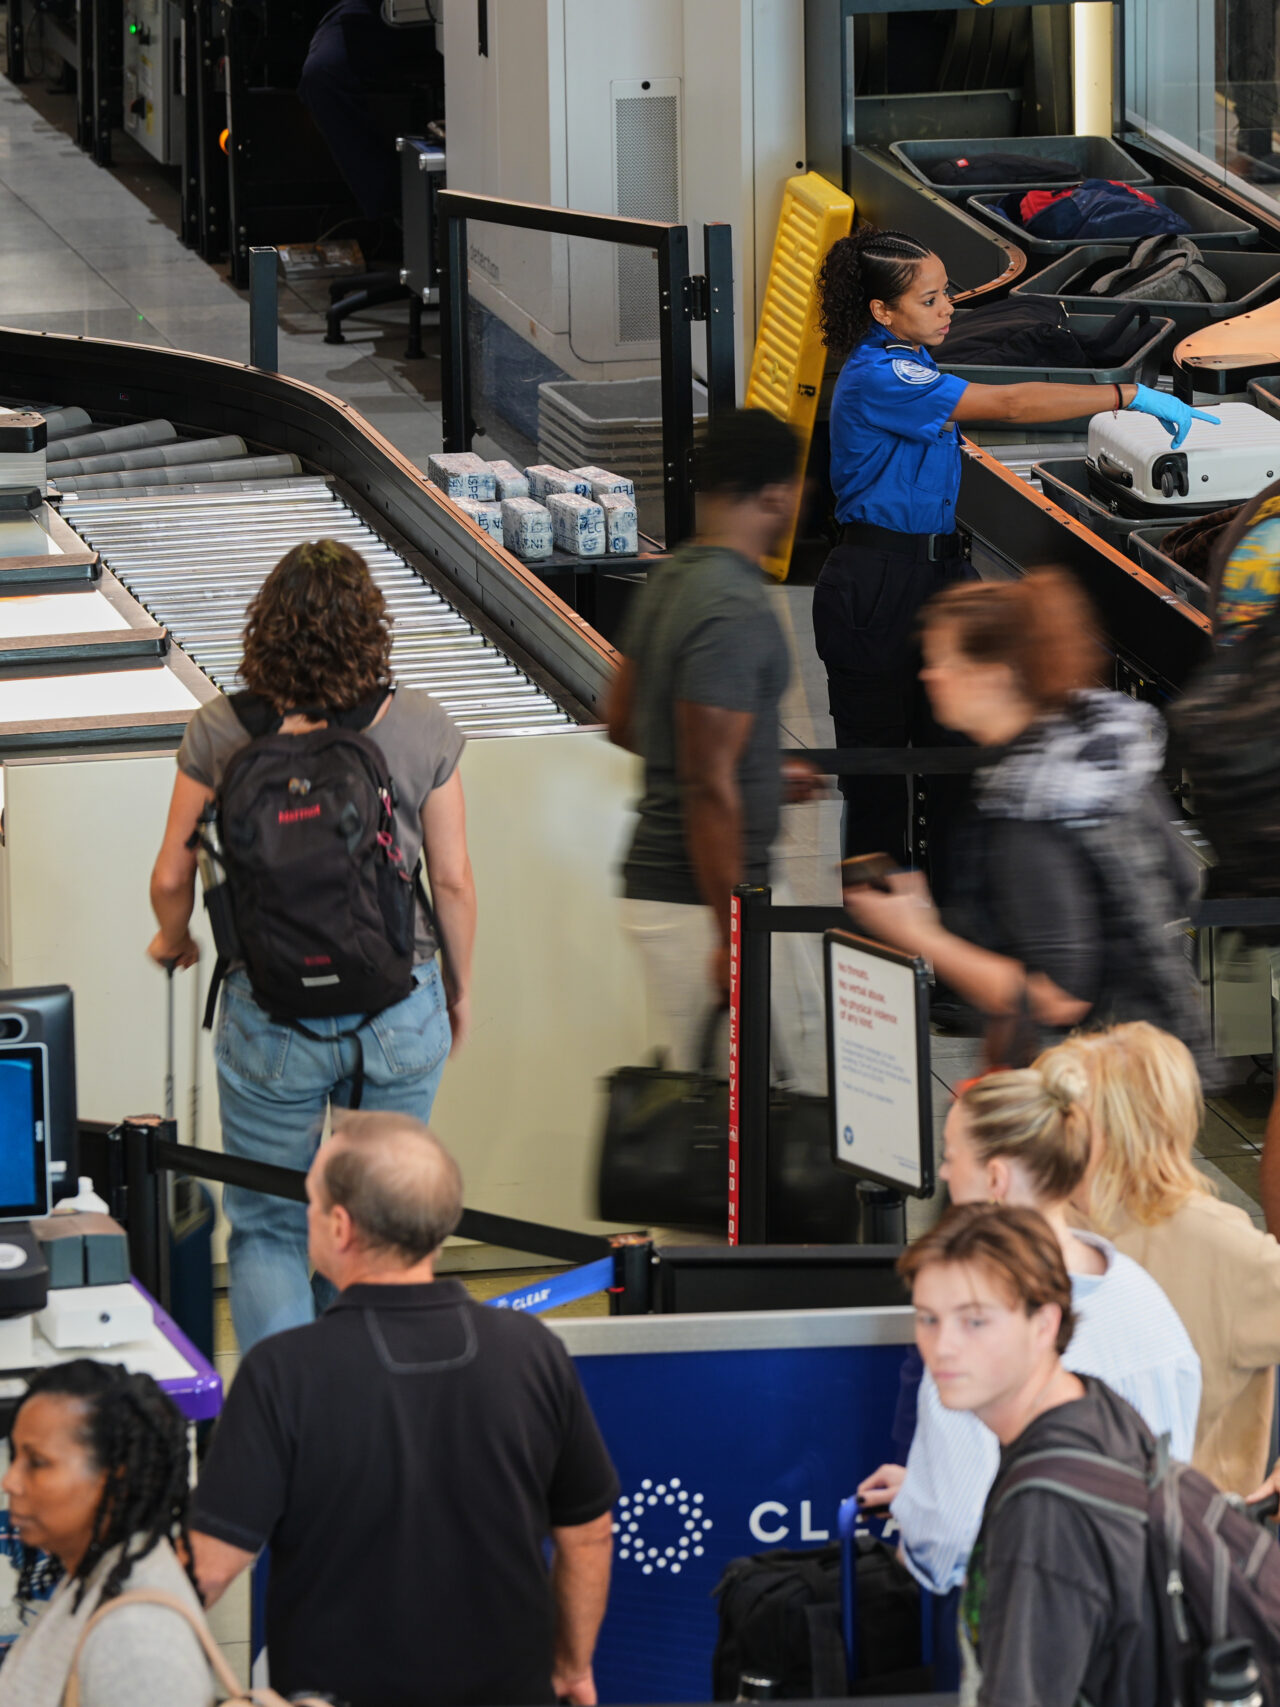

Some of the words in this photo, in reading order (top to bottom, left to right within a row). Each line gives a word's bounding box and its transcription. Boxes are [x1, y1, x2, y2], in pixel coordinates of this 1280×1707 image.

[730, 900, 738, 932] DO
[730, 942, 738, 993] NOT
[729, 1005, 737, 1111] REMOVE
